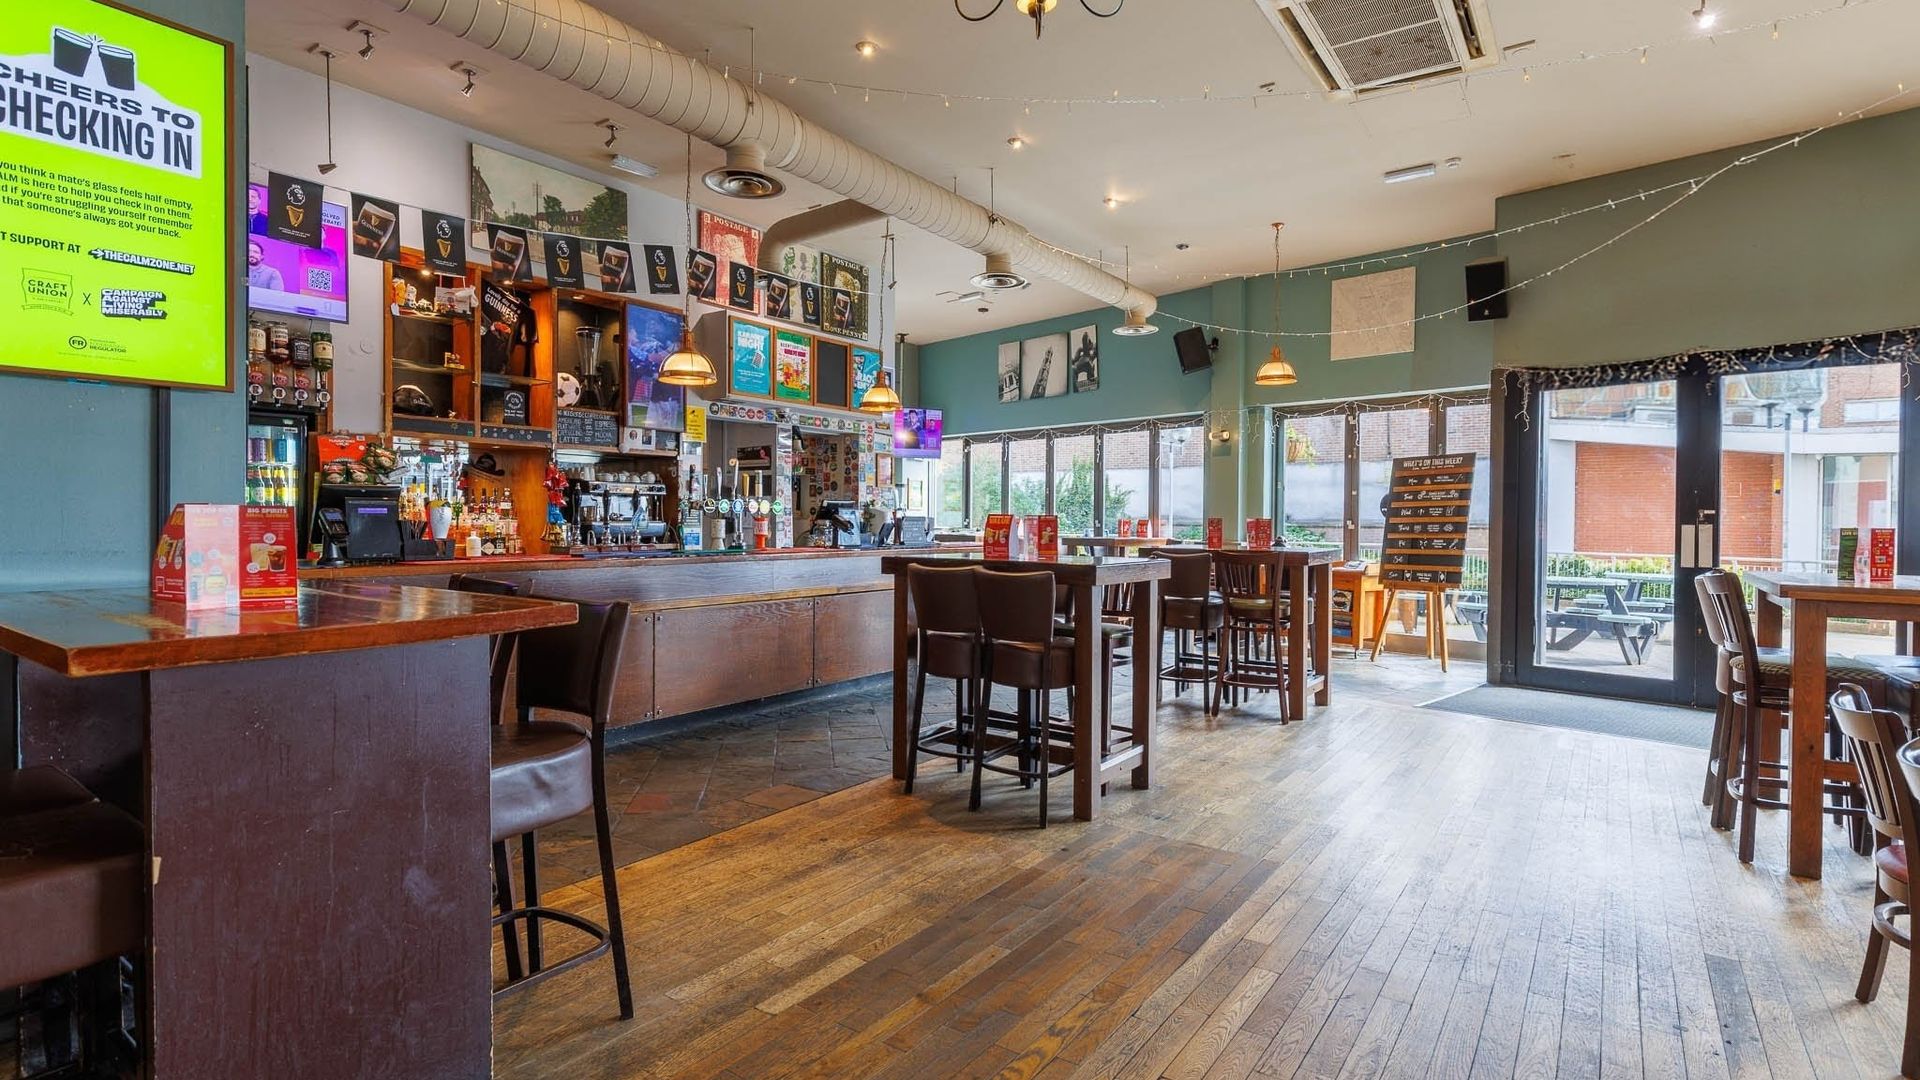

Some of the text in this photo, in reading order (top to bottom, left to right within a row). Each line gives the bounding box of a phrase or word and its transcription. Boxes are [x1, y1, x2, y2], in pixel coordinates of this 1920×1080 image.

[151, 106, 195, 130] TO
[163, 128, 192, 171] IN
[20, 164, 46, 178] think
[58, 174, 90, 187] mate's
[93, 182, 118, 193] glass
[120, 186, 142, 199] feels
[144, 192, 162, 203] half
[164, 198, 193, 211] empty,
[21, 177, 30, 185] is
[32, 178, 55, 190] here
[58, 184, 68, 193] to
[71, 187, 91, 198] help
[94, 193, 111, 203] you
[114, 197, 141, 209] check
[144, 203, 152, 211] in
[167, 208, 192, 220] them.
[2, 196, 182, 238] that someone's always got your back.
[11, 185, 18, 194] if
[21, 189, 52, 201] you're
[55, 196, 106, 214] struggling
[108, 207, 146, 220] yourself
[148, 215, 193, 230] remember
[10, 232, 65, 250] SUPPORT
[68, 243, 81, 254] AT
[104, 250, 195, 274] THECALMZONE.NET
[28, 279, 67, 291] CRAFT
[28, 286, 67, 297] UNION
[102, 289, 163, 298] CAMPAIGN
[102, 295, 152, 304] AGAINST
[102, 307, 164, 316] MISERABLY
[484, 293, 518, 322] GUINNESS
